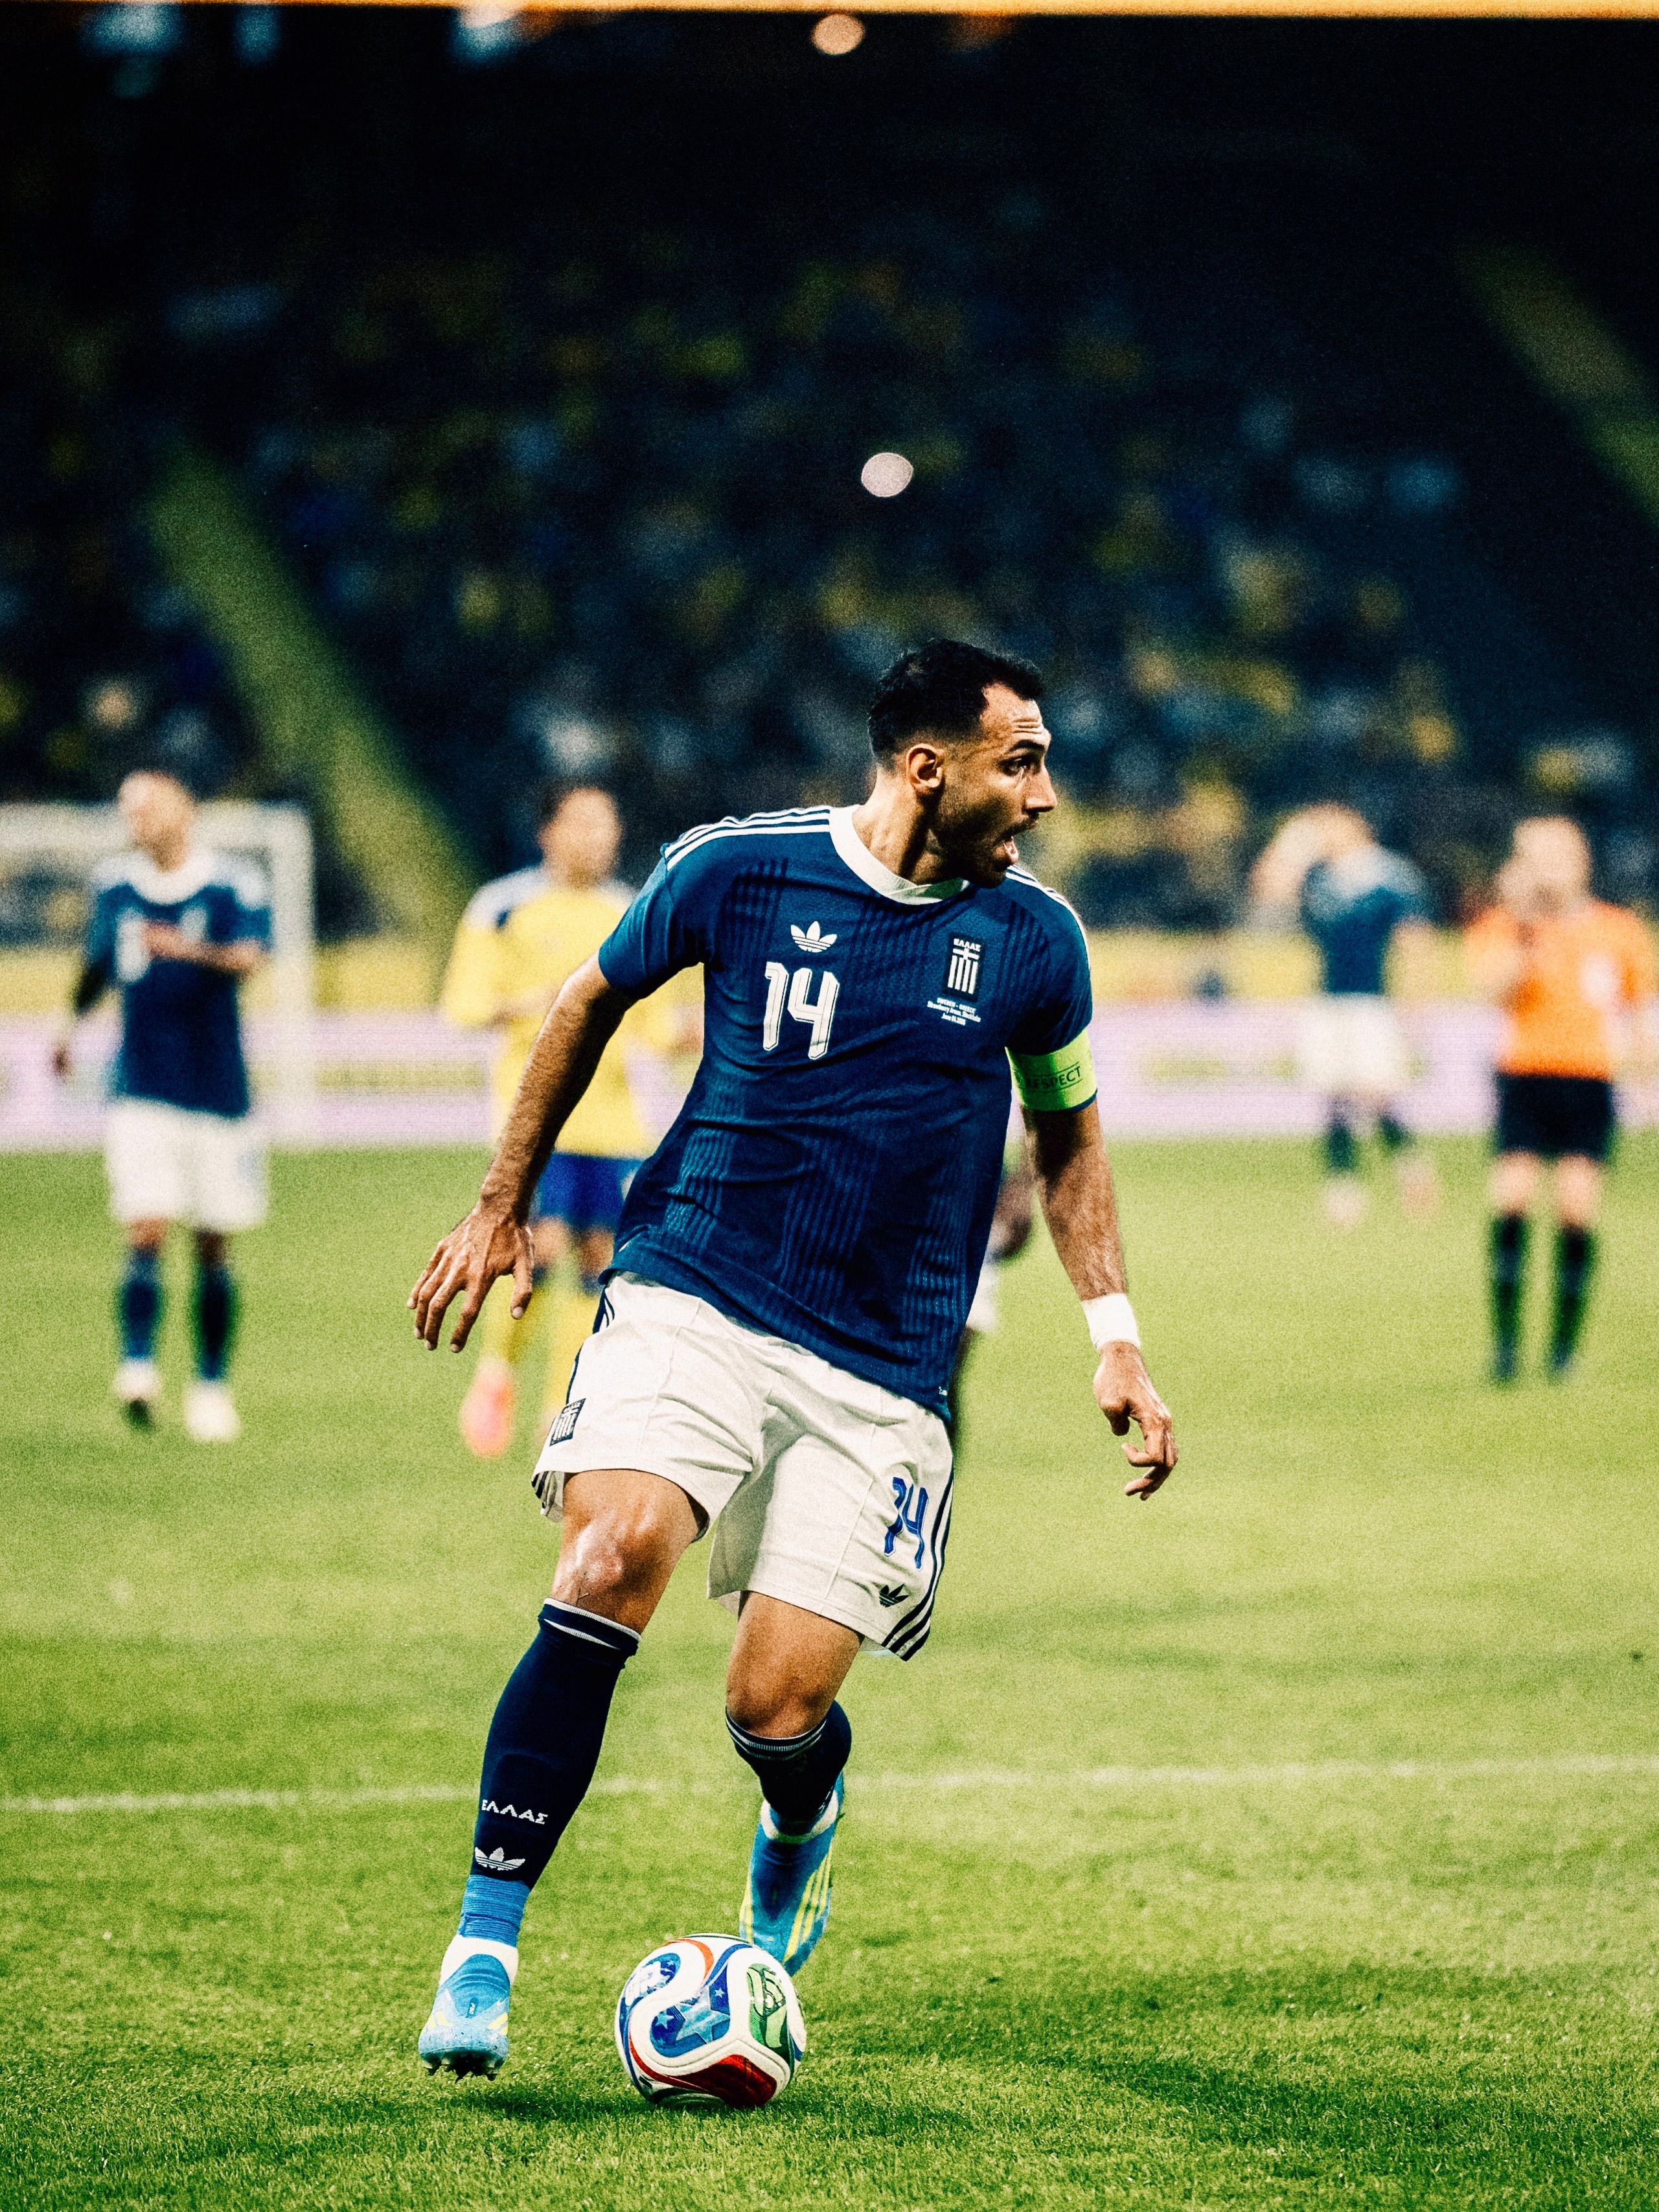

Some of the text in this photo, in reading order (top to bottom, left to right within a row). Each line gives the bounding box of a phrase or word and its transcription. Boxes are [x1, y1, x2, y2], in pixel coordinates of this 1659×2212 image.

[763, 961, 840, 1061] 14
[1025, 1066, 1081, 1090] RESPECT
[884, 1476, 930, 1572] 14
[481, 1799, 549, 1825] ΕΛΛΑΣ
